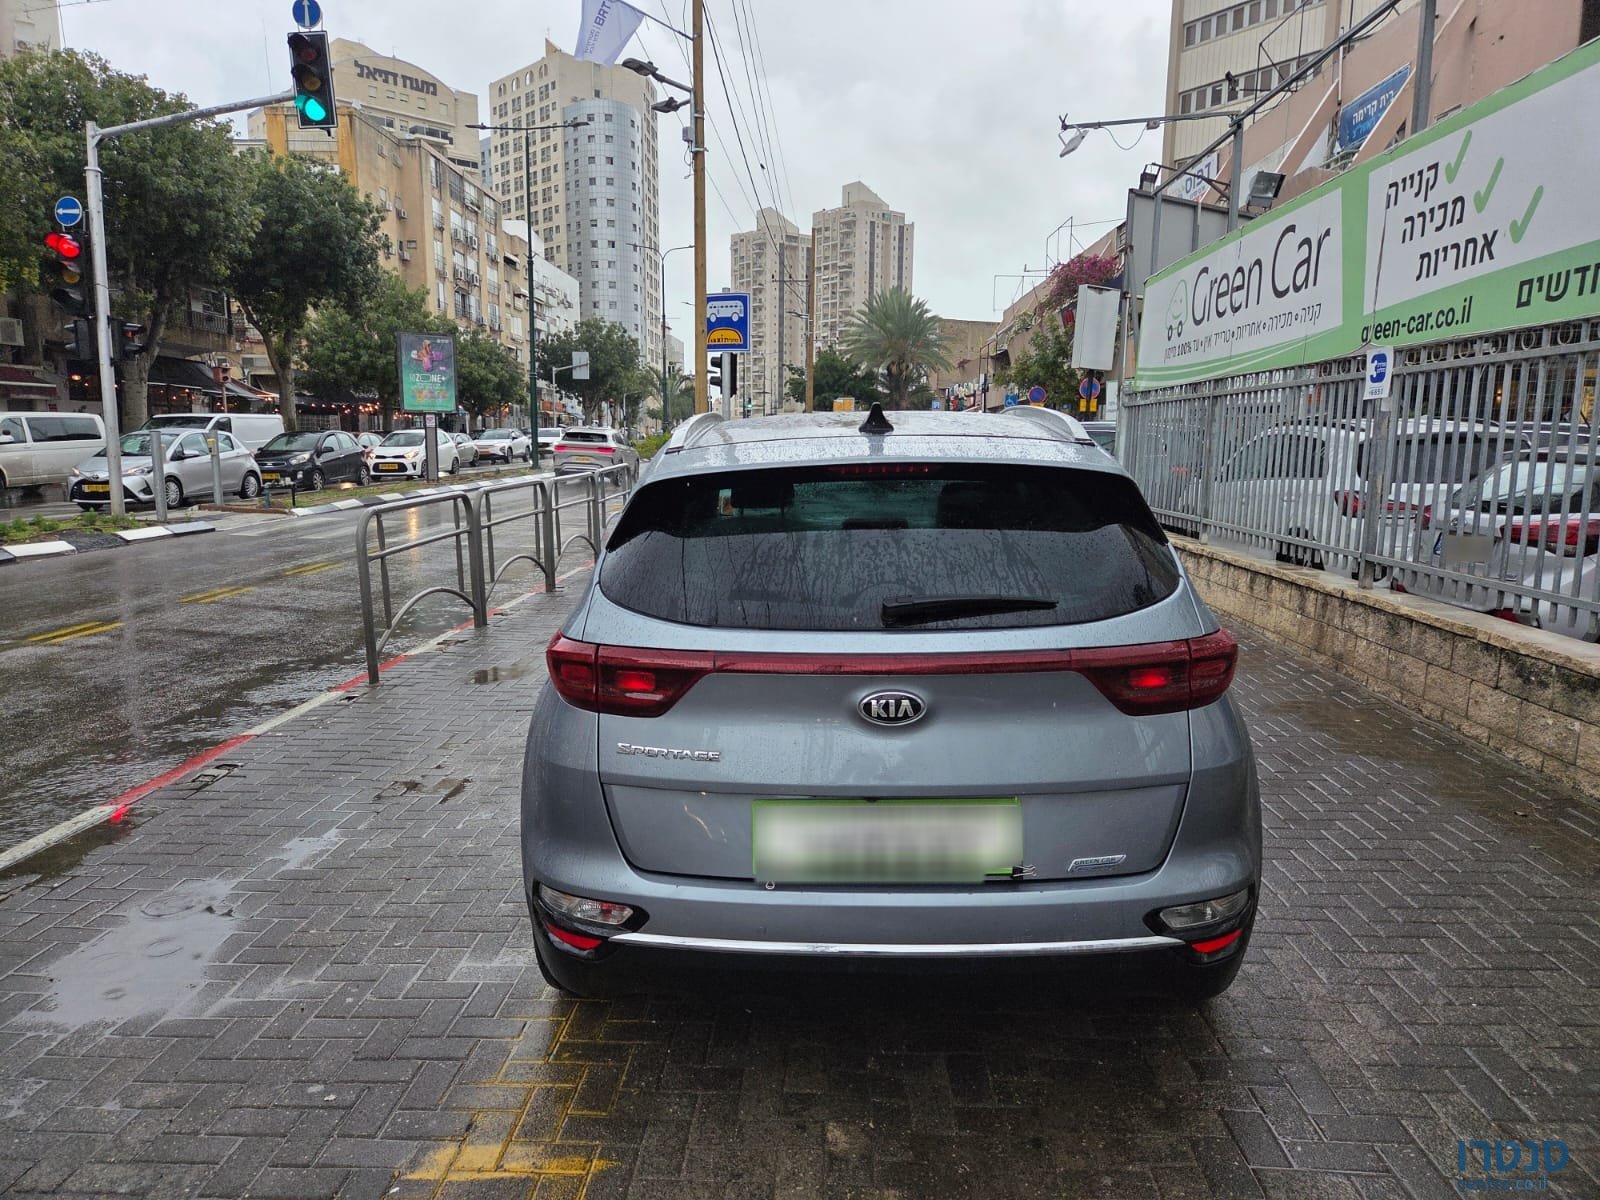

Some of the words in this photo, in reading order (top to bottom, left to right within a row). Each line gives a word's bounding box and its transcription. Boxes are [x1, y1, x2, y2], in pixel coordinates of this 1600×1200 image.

[594, 1, 611, 26] BRT
[353, 59, 399, 86] דניאל
[401, 74, 438, 96] מעוז
[1386, 161, 1439, 209] קנייה
[1401, 195, 1466, 244] מכירה
[1415, 229, 1499, 281] אחריות
[1192, 258, 1263, 326] Green
[1271, 224, 1331, 298] Car
[1267, 311, 1293, 333] מכירה
[1299, 303, 1322, 326] קניה
[1235, 321, 1262, 341] אחריות
[870, 698, 914, 718] KIA
[616, 742, 721, 762] SPORTAGE
